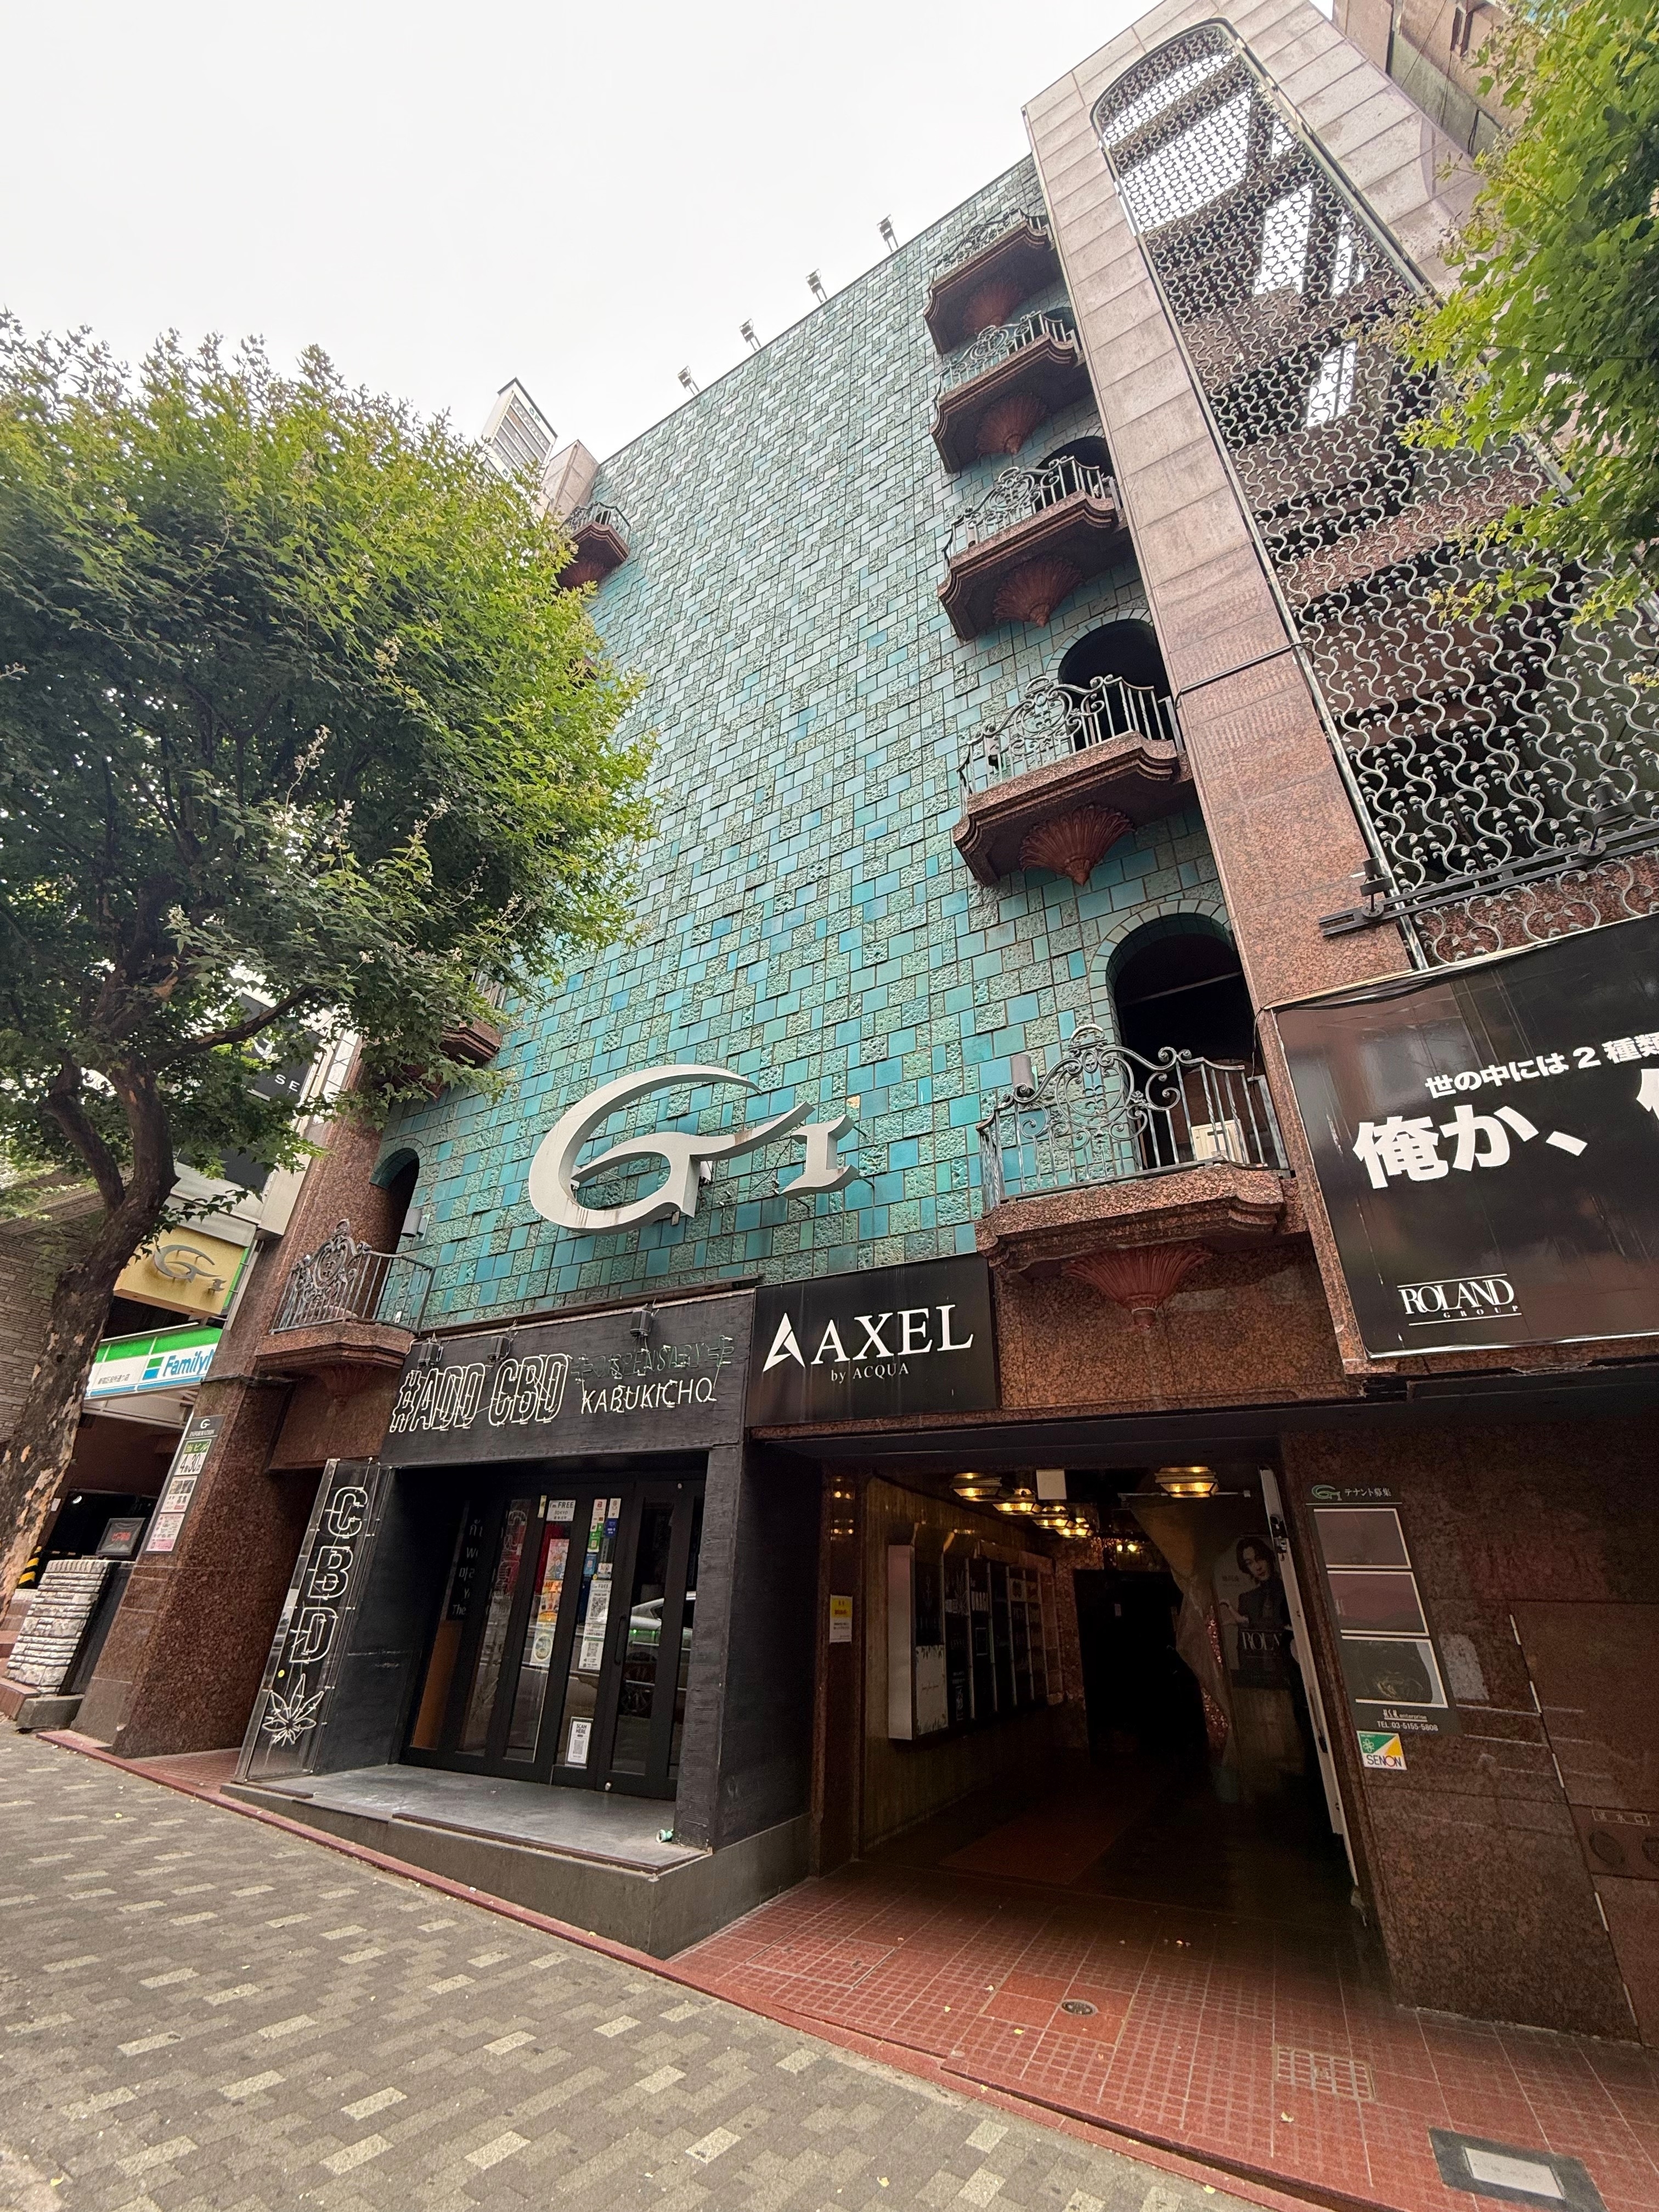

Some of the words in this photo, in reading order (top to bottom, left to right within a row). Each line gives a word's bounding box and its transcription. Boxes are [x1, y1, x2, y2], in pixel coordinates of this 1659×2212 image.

[1352, 1104, 1588, 1189] 俺か、
[1398, 1279, 1515, 1314] ROLAND
[1443, 1305, 1519, 1318] GROUP
[810, 1304, 974, 1365] AXEL
[831, 1369, 847, 1384] by
[853, 1362, 909, 1380] ACQUA
[1366, 1754, 1403, 1768] SENON
